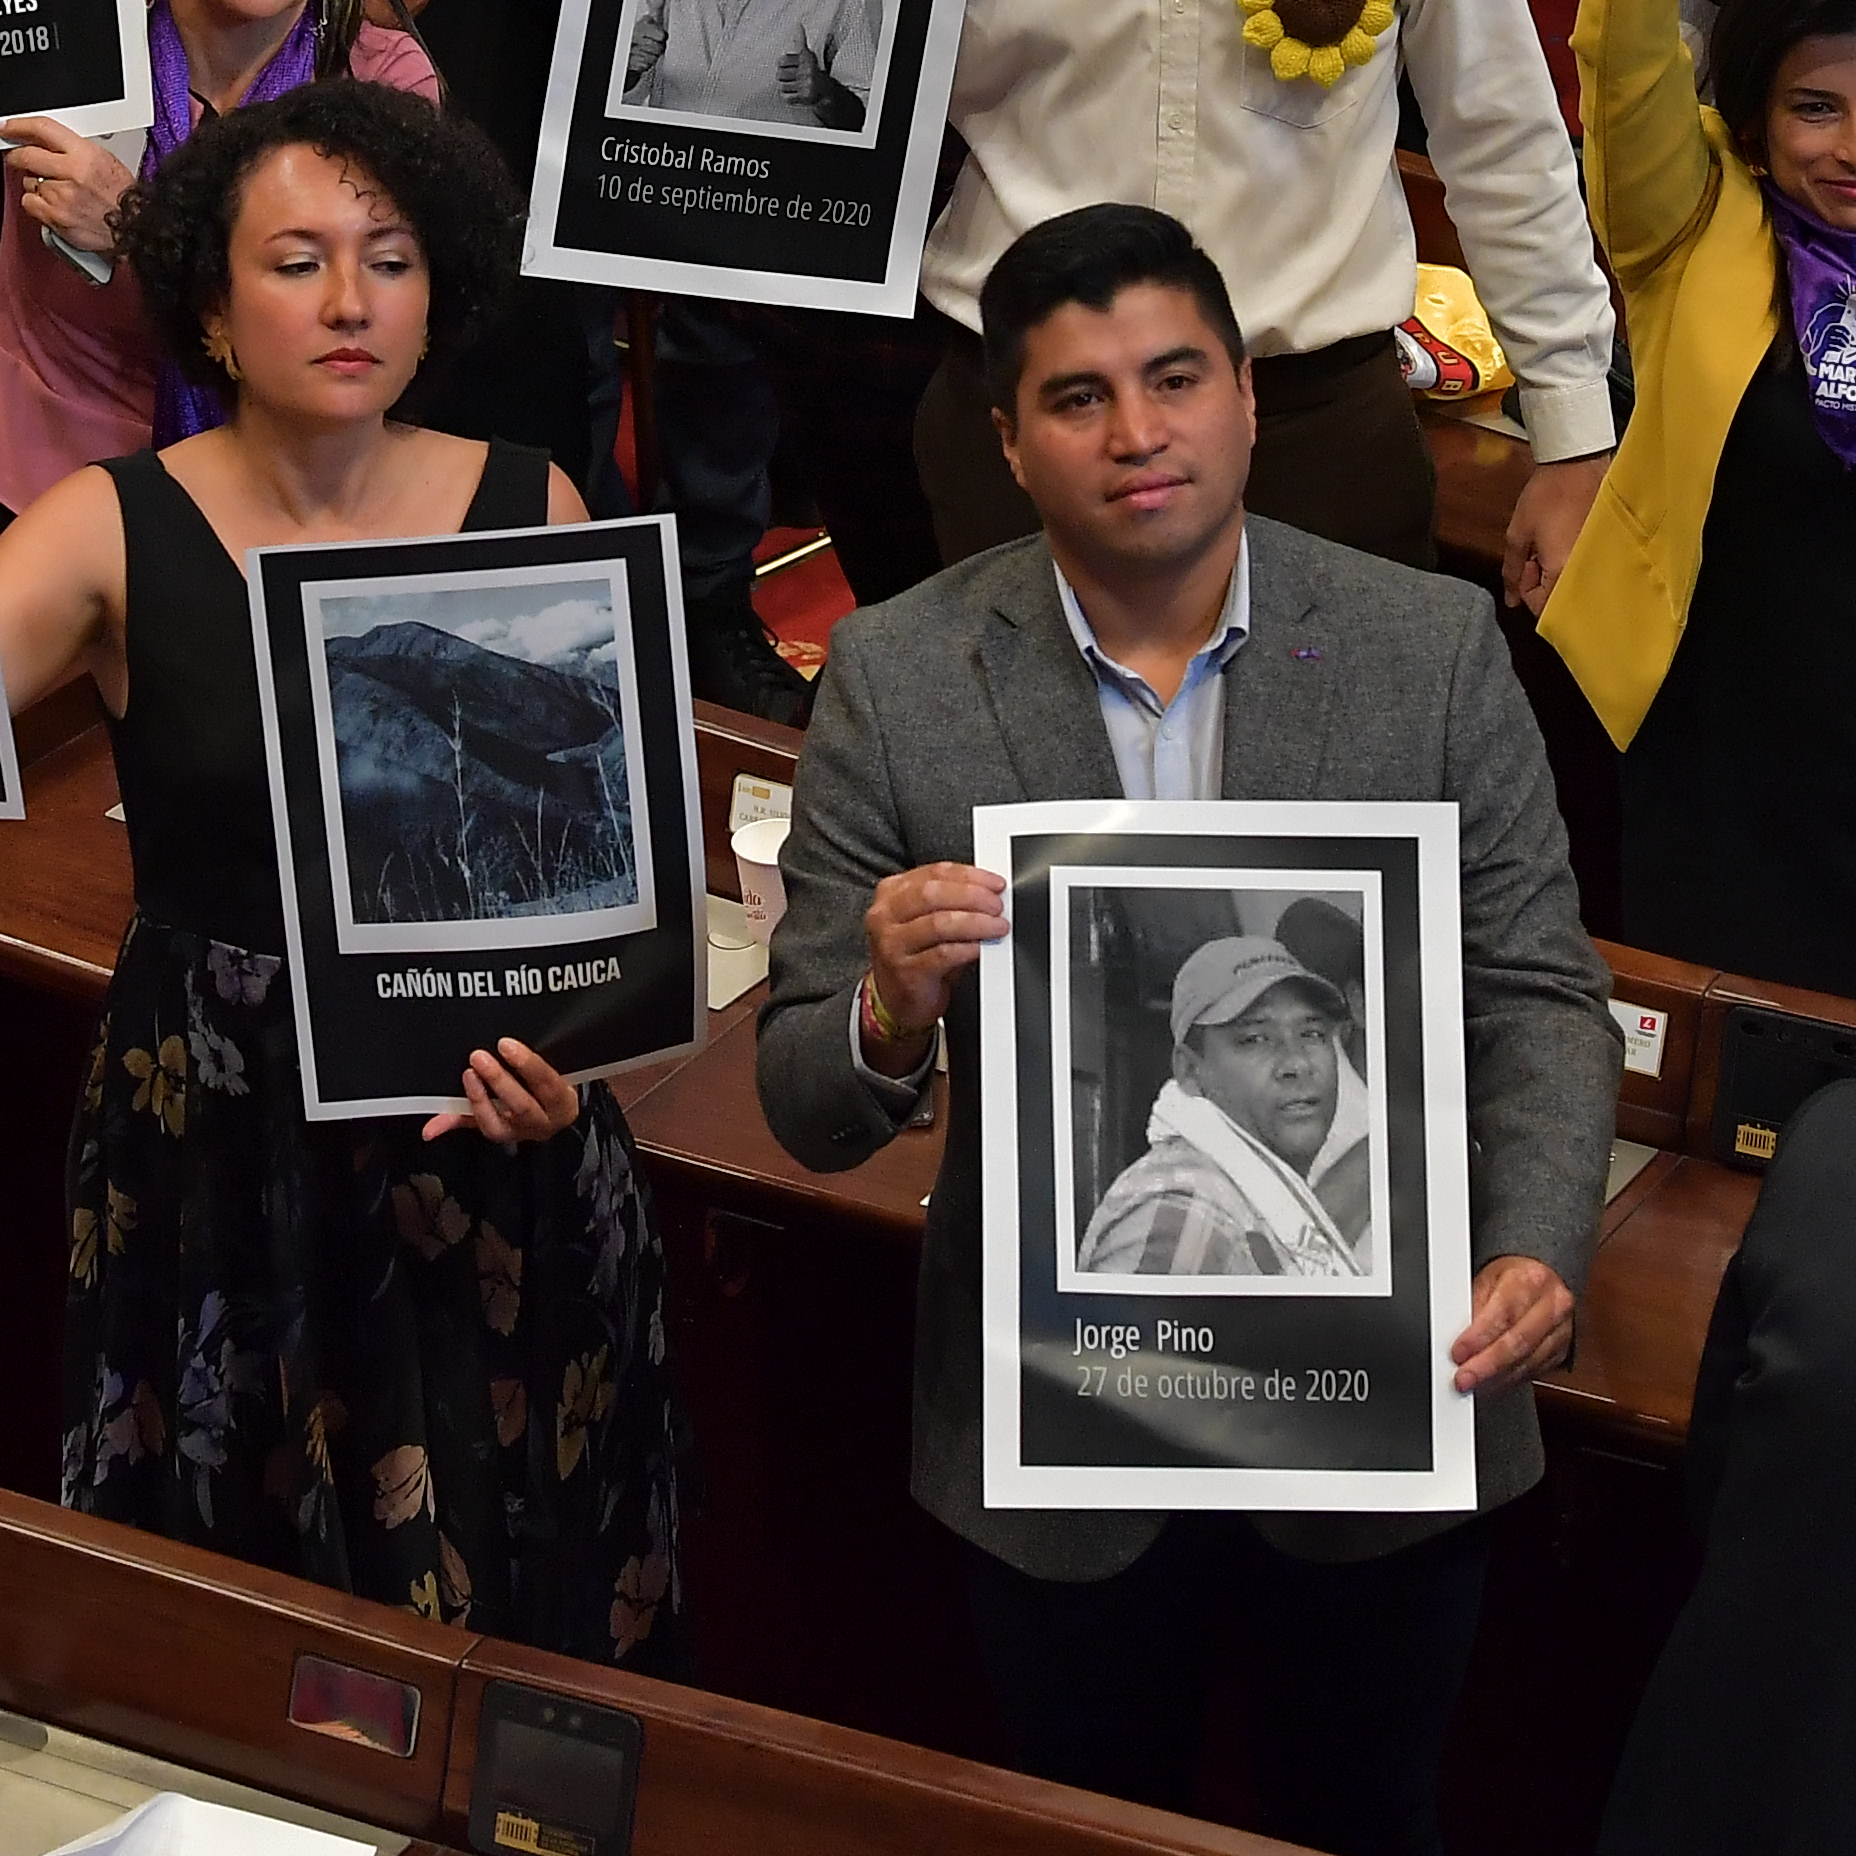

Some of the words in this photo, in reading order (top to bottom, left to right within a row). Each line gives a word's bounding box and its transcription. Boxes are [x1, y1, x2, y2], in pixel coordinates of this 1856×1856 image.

[601, 137, 694, 170] Cristobal
[700, 149, 770, 179] Ramos
[597, 174, 621, 199] 10
[628, 177, 654, 204] de
[660, 185, 780, 217] septiembre
[786, 195, 812, 221] de
[818, 199, 871, 227] 2020
[1814, 398, 1840, 409] PACTO
[376, 968, 453, 998] CAÑÓN
[458, 971, 501, 997] DEL
[505, 964, 543, 996] RÍO
[548, 956, 622, 992] CAUCA
[1073, 1318, 1141, 1359] Jorge
[1156, 1319, 1215, 1352] Pino
[1077, 1366, 1107, 1396] 27
[1116, 1366, 1149, 1397] de
[1157, 1369, 1256, 1401] octubre
[1263, 1368, 1296, 1400] de
[1305, 1369, 1370, 1402] 2020
